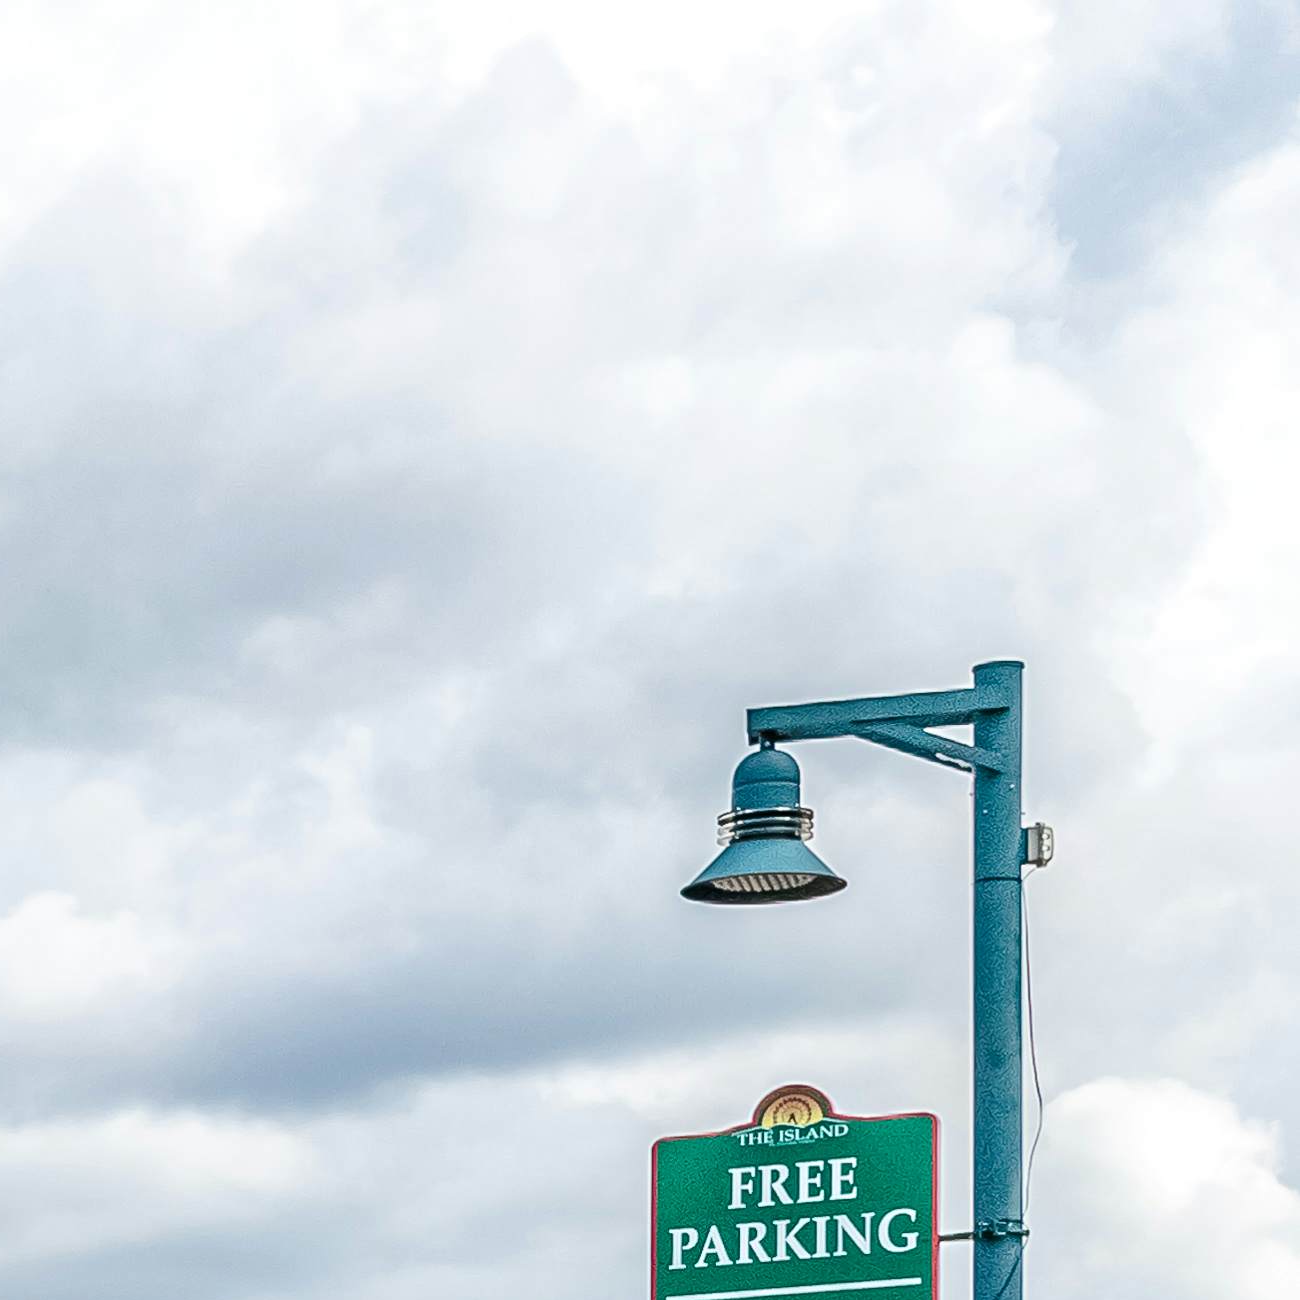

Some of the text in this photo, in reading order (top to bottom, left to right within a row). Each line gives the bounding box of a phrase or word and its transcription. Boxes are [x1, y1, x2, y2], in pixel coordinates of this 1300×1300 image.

[737, 1130, 774, 1146] THE
[780, 1124, 849, 1142] ISLAND
[727, 1156, 858, 1210] FREE
[668, 1207, 920, 1271] PARKING
